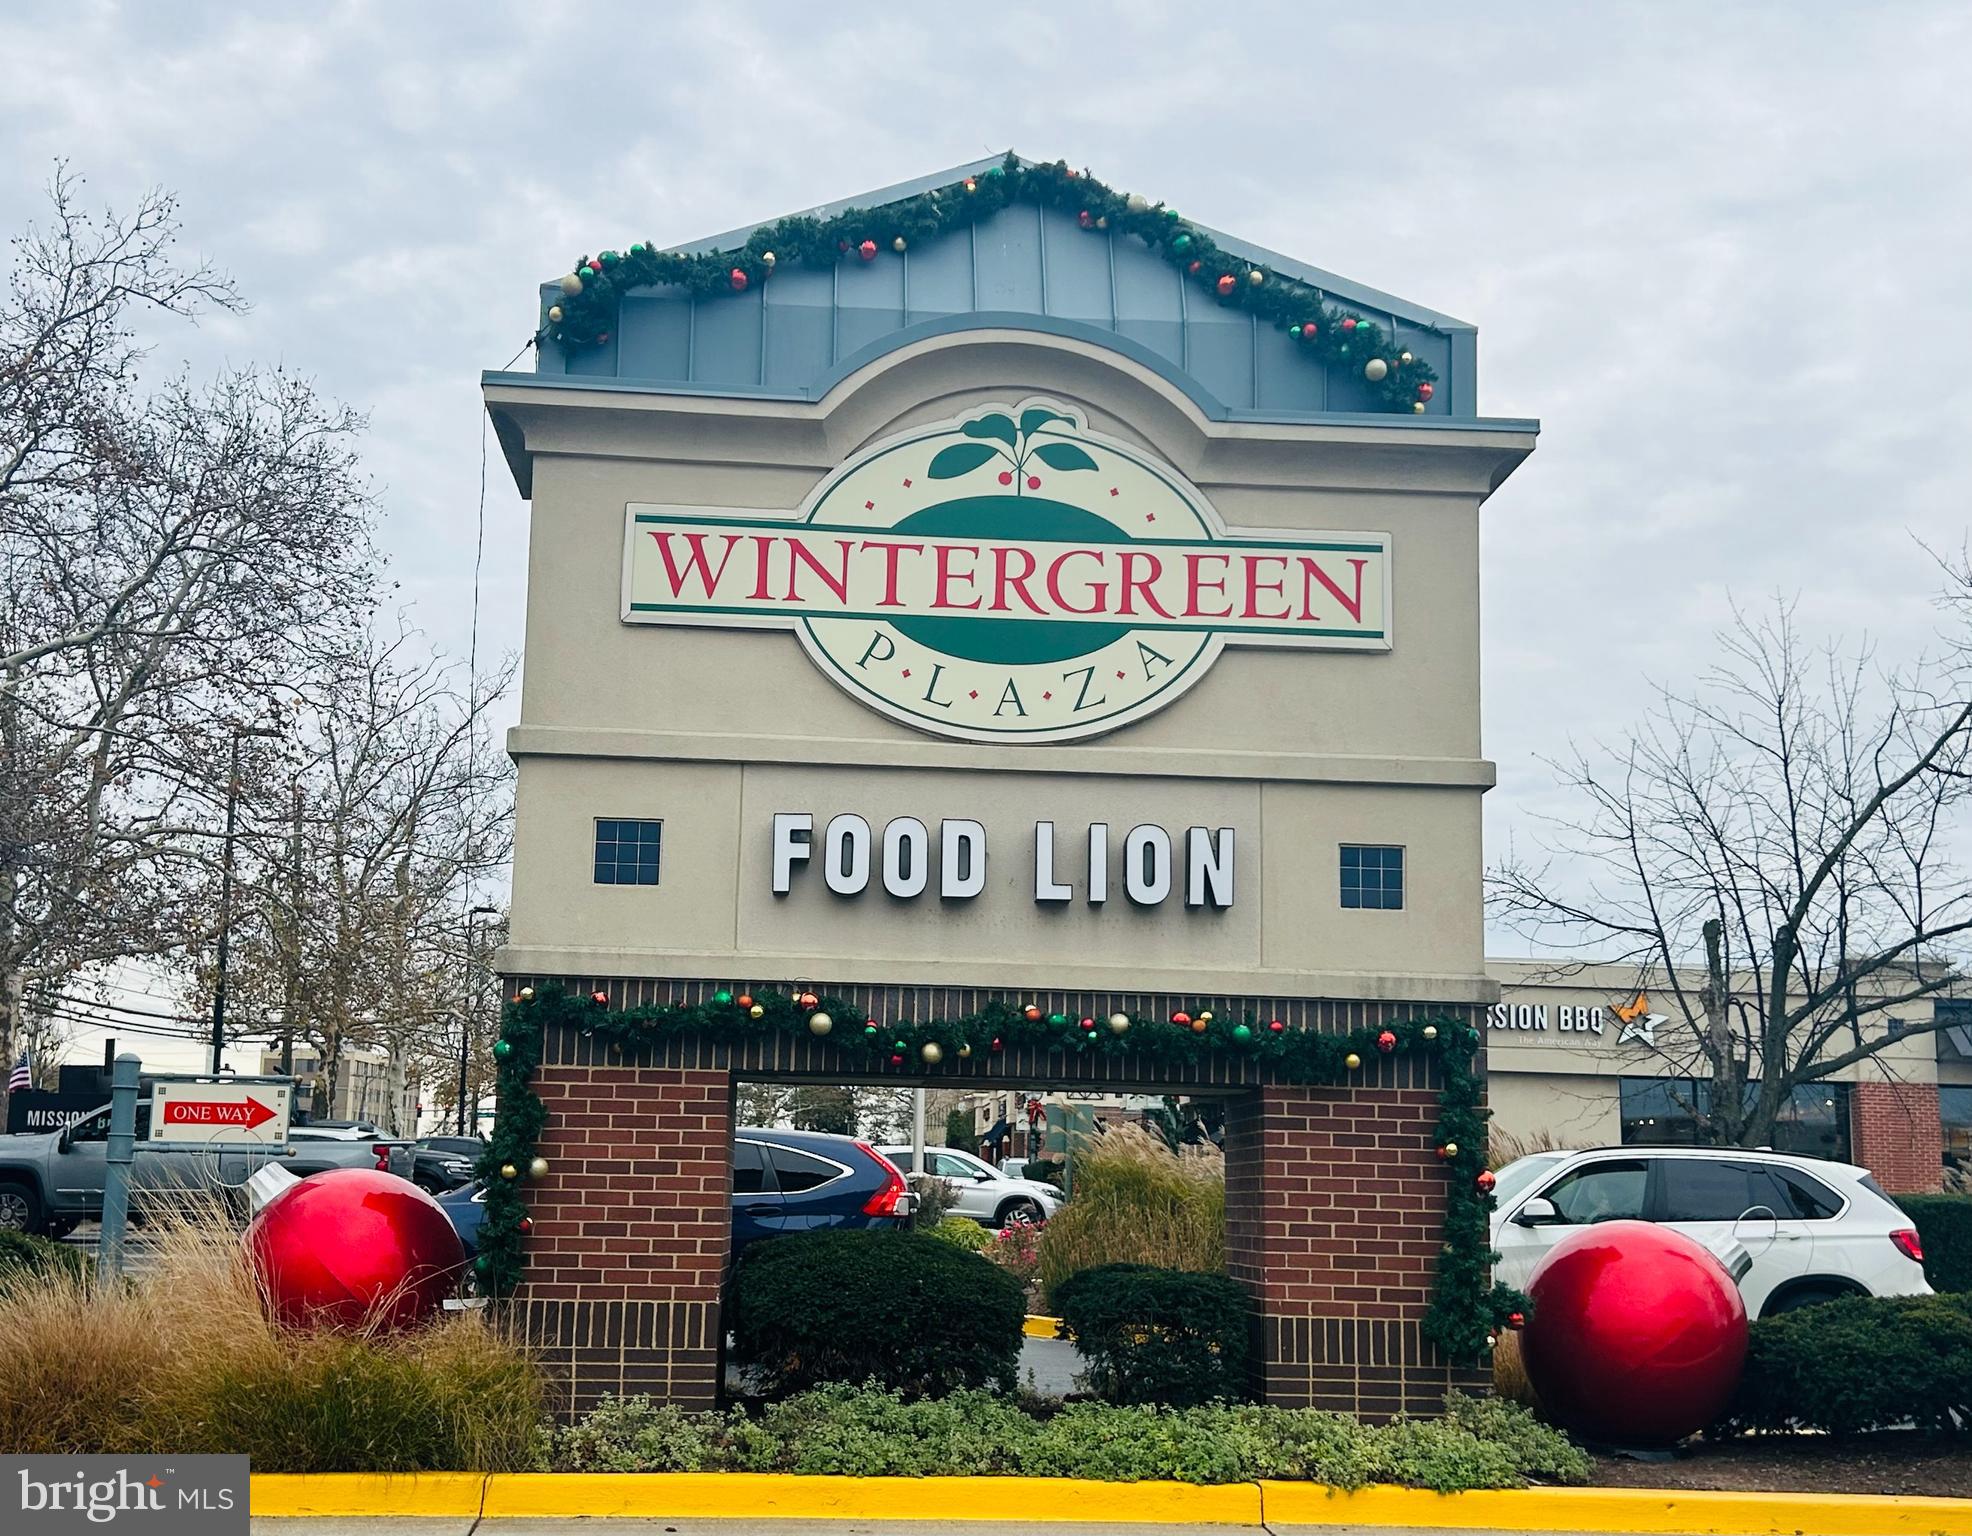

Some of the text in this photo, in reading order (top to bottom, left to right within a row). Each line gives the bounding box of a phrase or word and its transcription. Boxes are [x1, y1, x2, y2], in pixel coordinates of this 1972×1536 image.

[647, 531, 1368, 624] WINTERGREEN
[855, 629, 1175, 717] PLAZA
[772, 813, 1236, 909] FOOD LION
[1518, 1035, 1535, 1045] The
[1537, 1036, 1581, 1046] American
[1559, 1005, 1603, 1035] BBQ
[173, 1105, 256, 1121] ONE WAY
